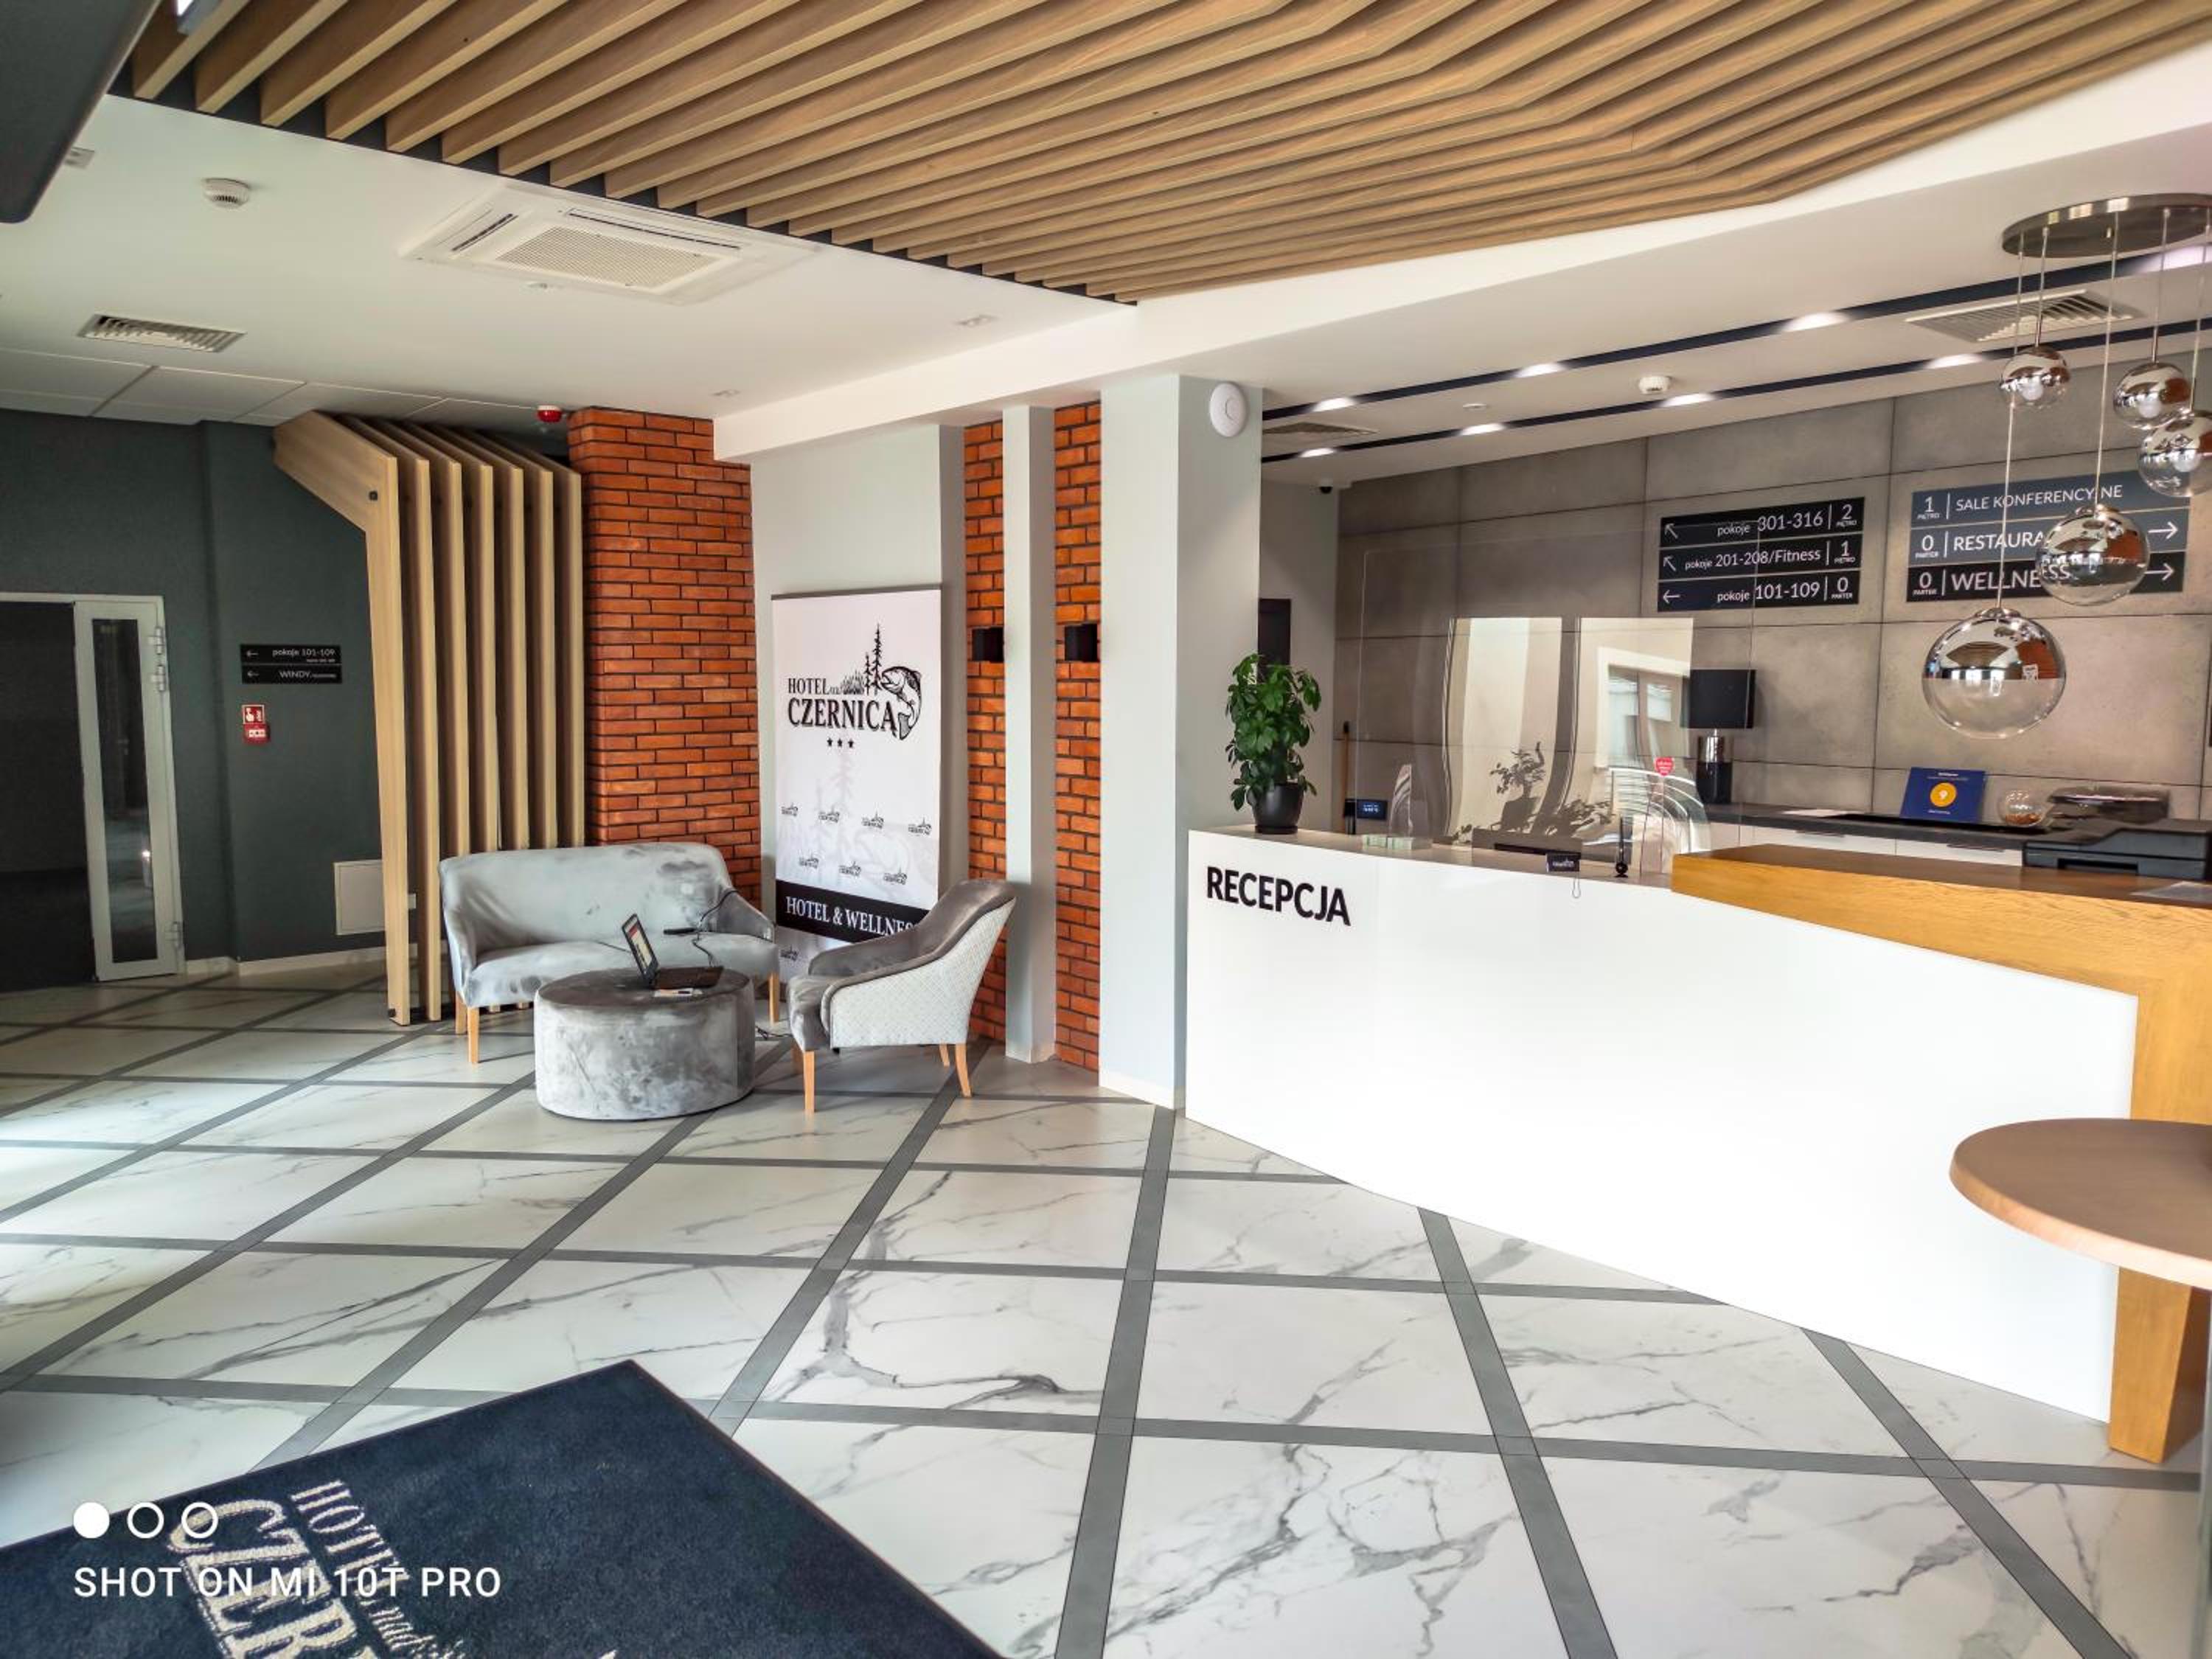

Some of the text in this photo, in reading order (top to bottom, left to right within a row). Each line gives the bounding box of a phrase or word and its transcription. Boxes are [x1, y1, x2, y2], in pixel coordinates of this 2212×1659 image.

[1924, 484, 2124, 512] 1 SALE KONFERENCYNE
[1717, 504, 1854, 537] pokoje 301-316 2
[1684, 540, 1850, 571] pokoje 201-208/Fitness 1
[1921, 531, 2045, 552] 0 RESTAURA
[1717, 577, 1849, 603] pokoje 101-109 0
[1919, 572, 1933, 589] 0
[272, 648, 299, 658] pokoje
[788, 678, 830, 695] HOTEL
[788, 698, 897, 734] CZERNICA
[1207, 866, 1352, 926] RECEPCJA
[786, 896, 915, 936] HOTEL & WELLNE
[167, 1498, 379, 1659] CZER
